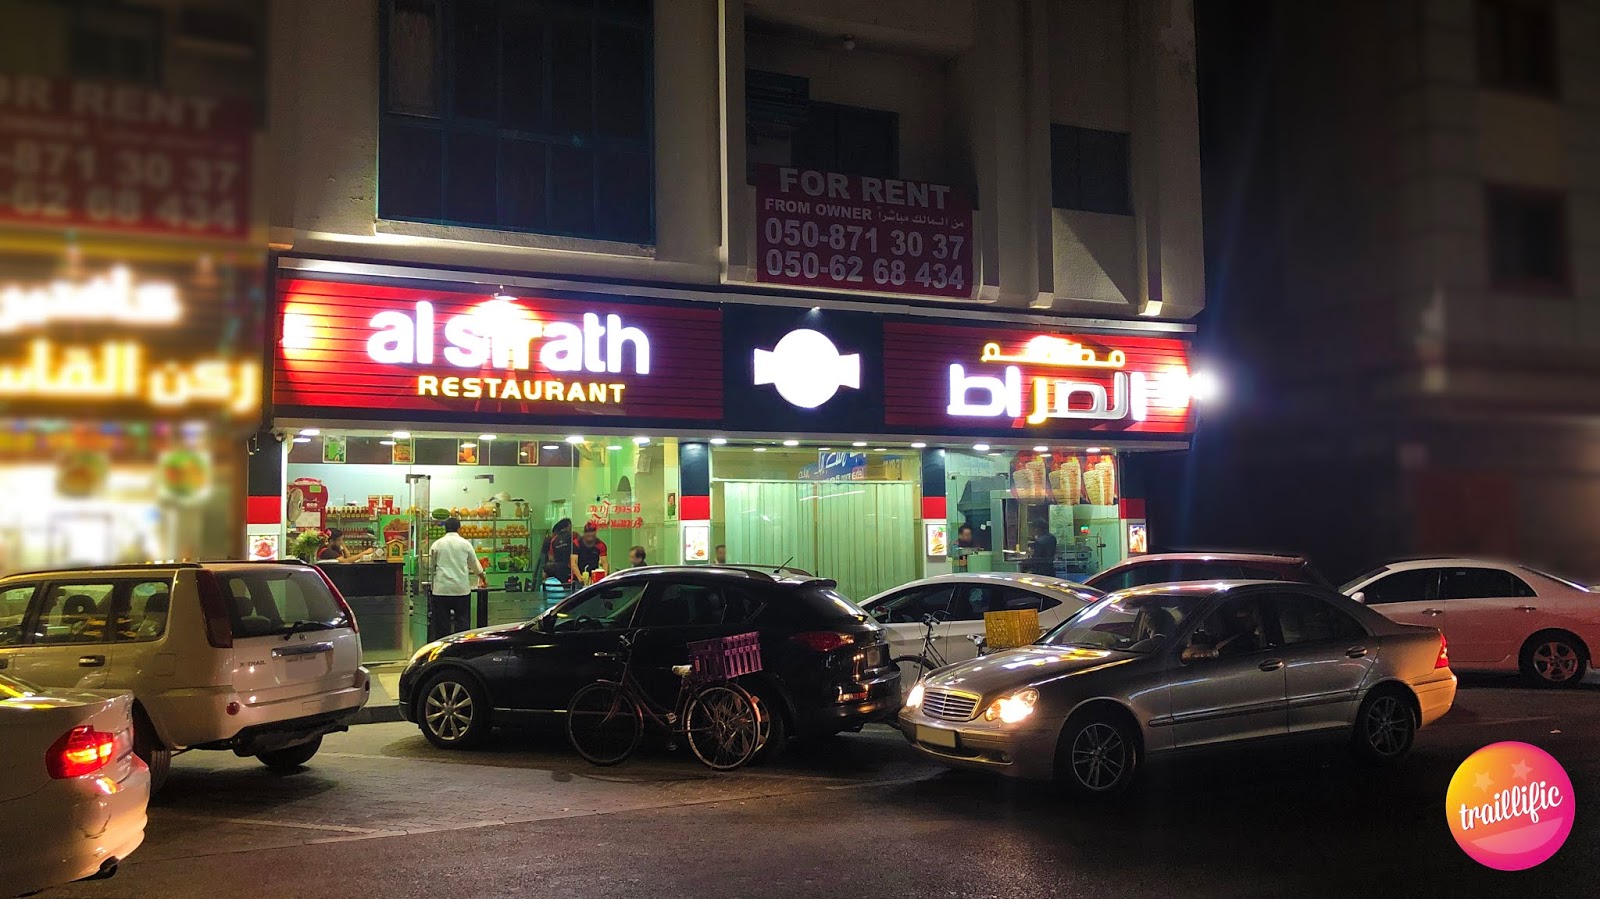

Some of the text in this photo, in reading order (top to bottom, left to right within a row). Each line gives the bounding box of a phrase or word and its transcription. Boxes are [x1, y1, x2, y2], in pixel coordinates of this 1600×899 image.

[764, 197, 872, 221] FROM OWNER
[779, 167, 950, 209] FOR RENT
[765, 217, 965, 261] 050-871 30 37
[765, 248, 965, 290] 050-62 68 434
[366, 300, 434, 365] al
[417, 374, 626, 403] RESTAURANT
[946, 362, 1147, 425] الصراط
